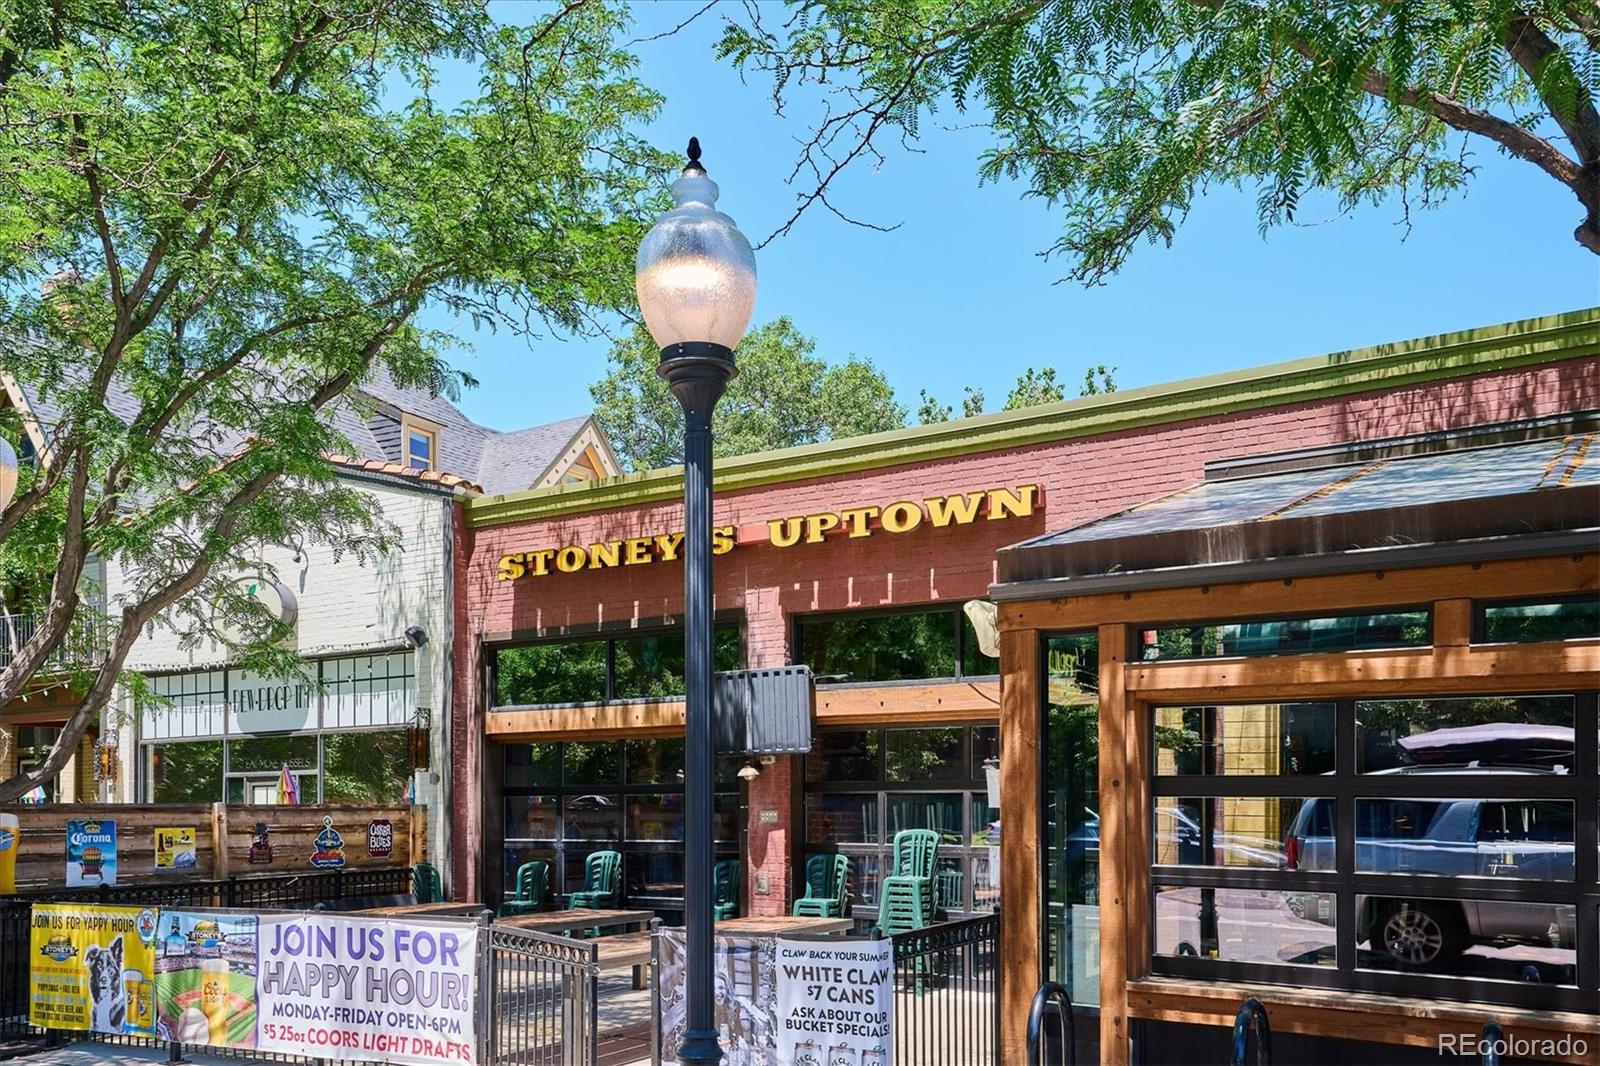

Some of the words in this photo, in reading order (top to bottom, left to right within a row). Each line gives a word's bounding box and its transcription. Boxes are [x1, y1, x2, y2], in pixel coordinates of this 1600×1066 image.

[498, 525, 737, 581] STONEYS
[767, 485, 1039, 547] UPTOWN
[70, 832, 112, 846] Corona
[370, 823, 391, 836] OSKAR
[370, 836, 391, 848] BLUES
[32, 914, 49, 928] JOIN
[52, 915, 63, 930] US
[66, 915, 80, 930] FOR
[83, 916, 108, 931] YAPPY
[111, 918, 135, 933] HOUR
[191, 932, 222, 940] STONEY'S
[270, 924, 336, 959] JOIN
[346, 927, 385, 961] US
[395, 929, 460, 967] FOR
[45, 945, 74, 953] STONEY'S
[782, 949, 807, 958] CLAW
[809, 950, 832, 959] BACK
[834, 952, 858, 961] YOUR
[782, 965, 843, 983] WHITE
[847, 967, 889, 986] CLAW
[204, 982, 227, 996] Coors
[263, 961, 359, 1000] HAPPY
[366, 967, 469, 1012] HOUR!
[807, 985, 823, 1001] $7
[827, 986, 875, 1005] CANS
[272, 1002, 384, 1026] MONDAY-FRIDAY
[387, 1011, 461, 1035] OPEN-6PM
[791, 1007, 816, 1019] ASK
[818, 1008, 861, 1022] ABOUT
[863, 1011, 887, 1024] OUR
[785, 1019, 834, 1033] BUCKET
[836, 1023, 890, 1038] SPECIALS!
[264, 1024, 275, 1040] $5
[279, 1025, 305, 1042] 25oz
[307, 1028, 359, 1048] COORS
[364, 1034, 408, 1054] LIGHT
[412, 1038, 471, 1061] DRAFTS
